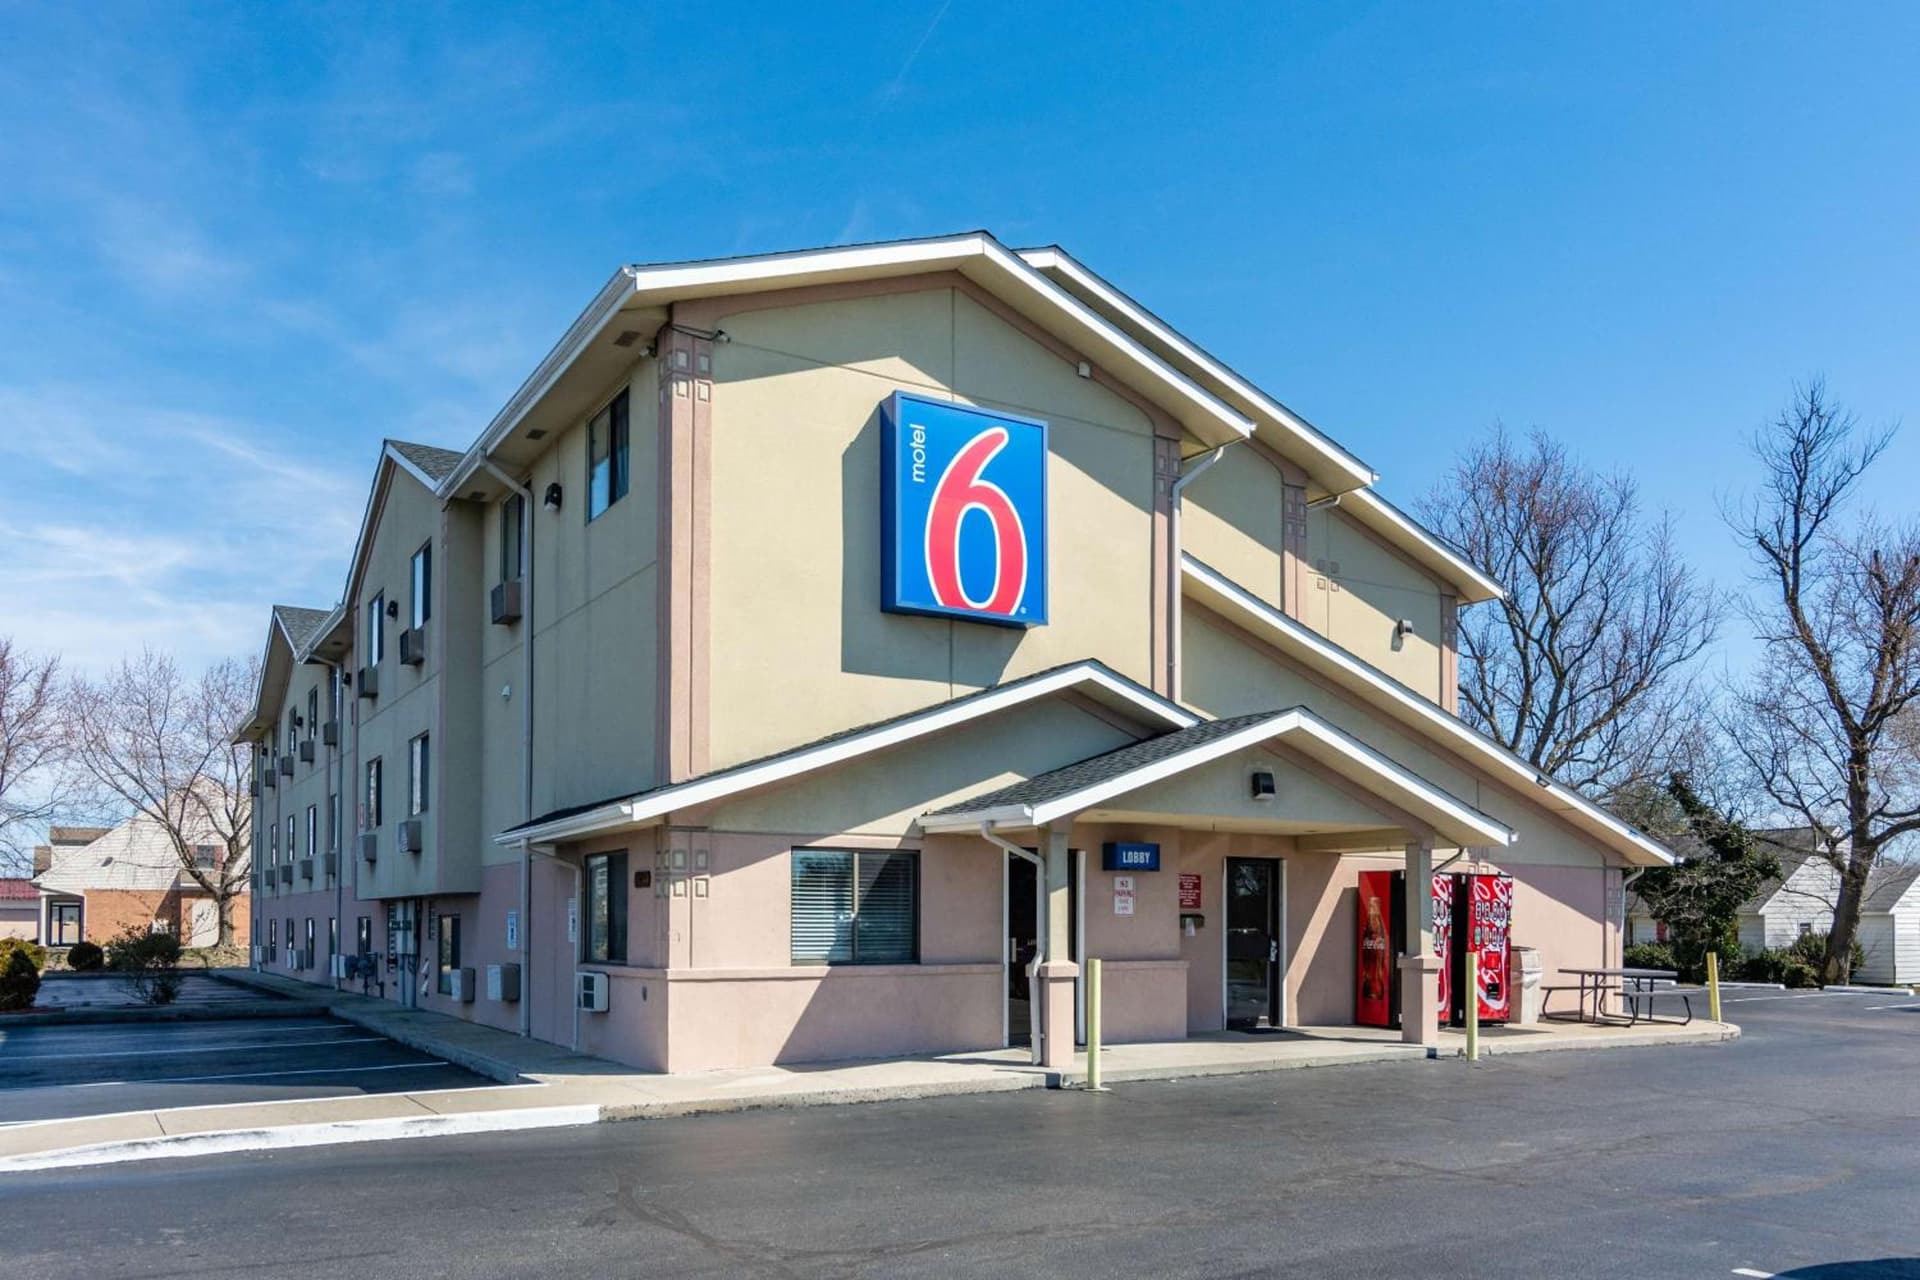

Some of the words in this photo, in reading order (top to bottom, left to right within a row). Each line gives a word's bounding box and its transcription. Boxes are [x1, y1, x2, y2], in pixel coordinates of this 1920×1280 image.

[910, 423, 925, 483] motel
[924, 426, 1028, 615] 6
[1122, 850, 1150, 864] LOBBY
